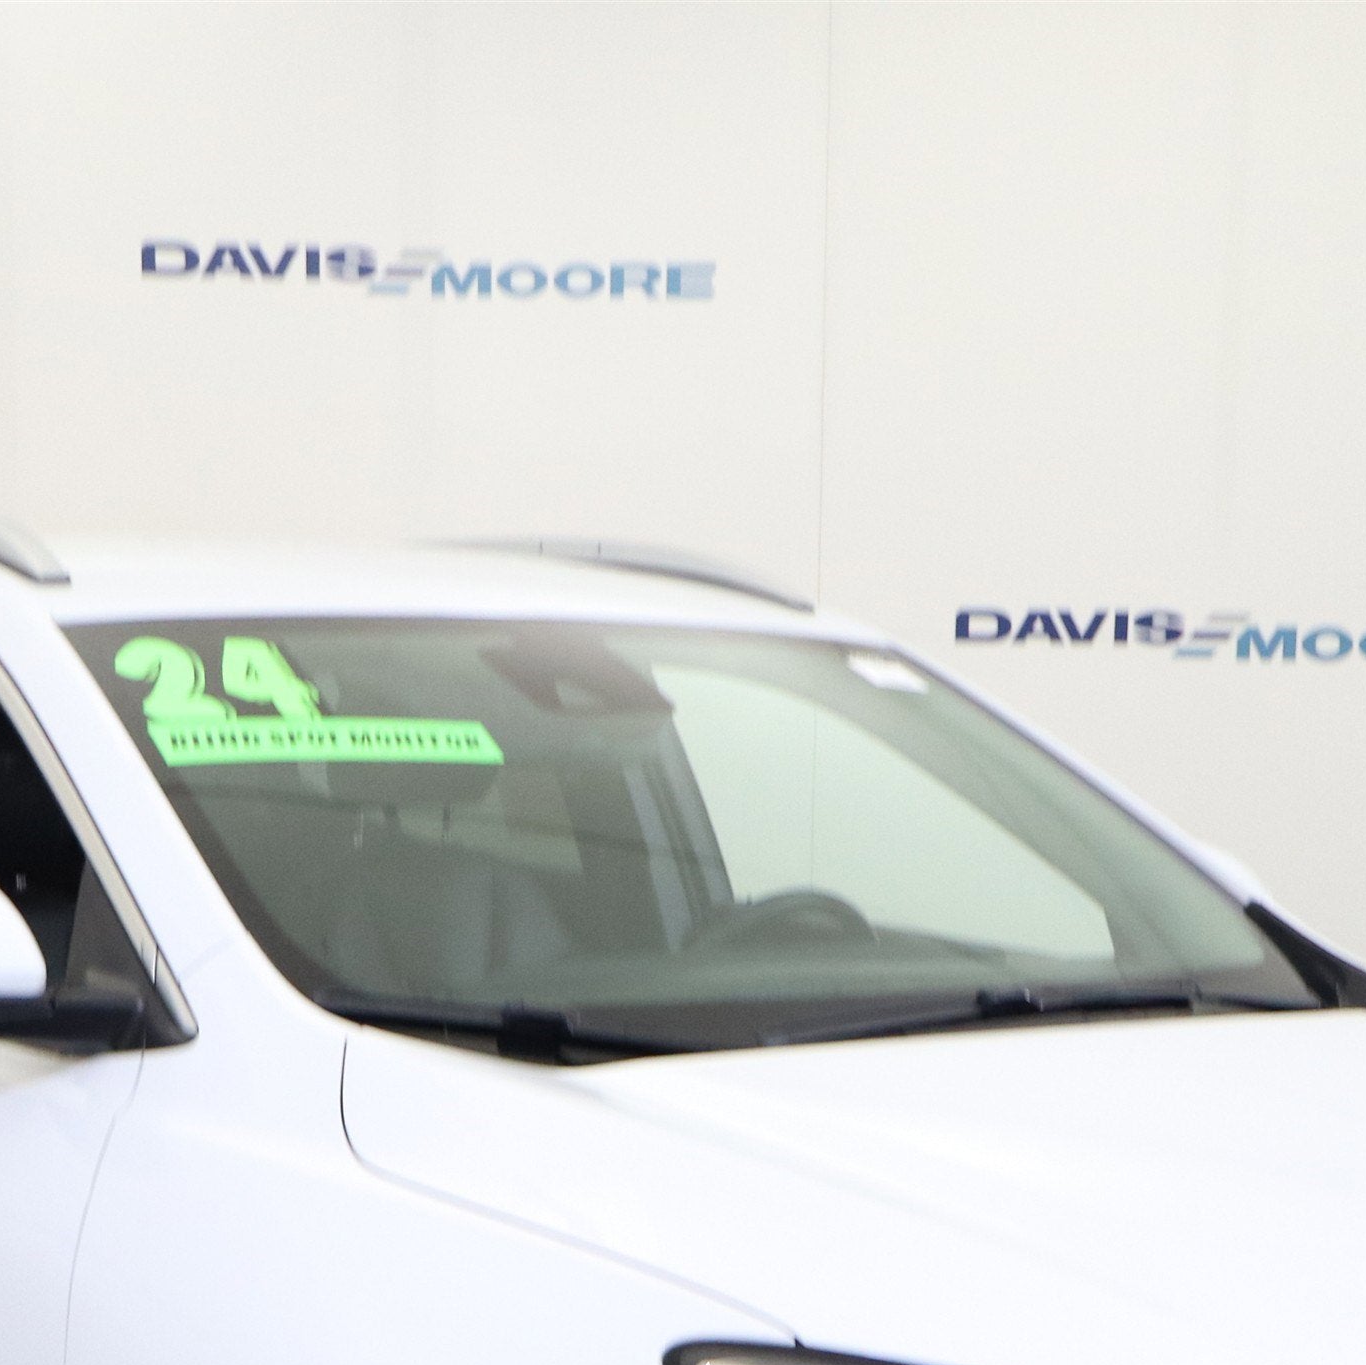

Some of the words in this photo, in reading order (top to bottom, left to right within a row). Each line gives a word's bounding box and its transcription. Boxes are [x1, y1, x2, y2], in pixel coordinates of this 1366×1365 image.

[141, 238, 377, 282] DAVIS
[431, 258, 716, 301] MOORE
[954, 606, 1183, 647] DAVIS
[114, 636, 320, 721] 24
